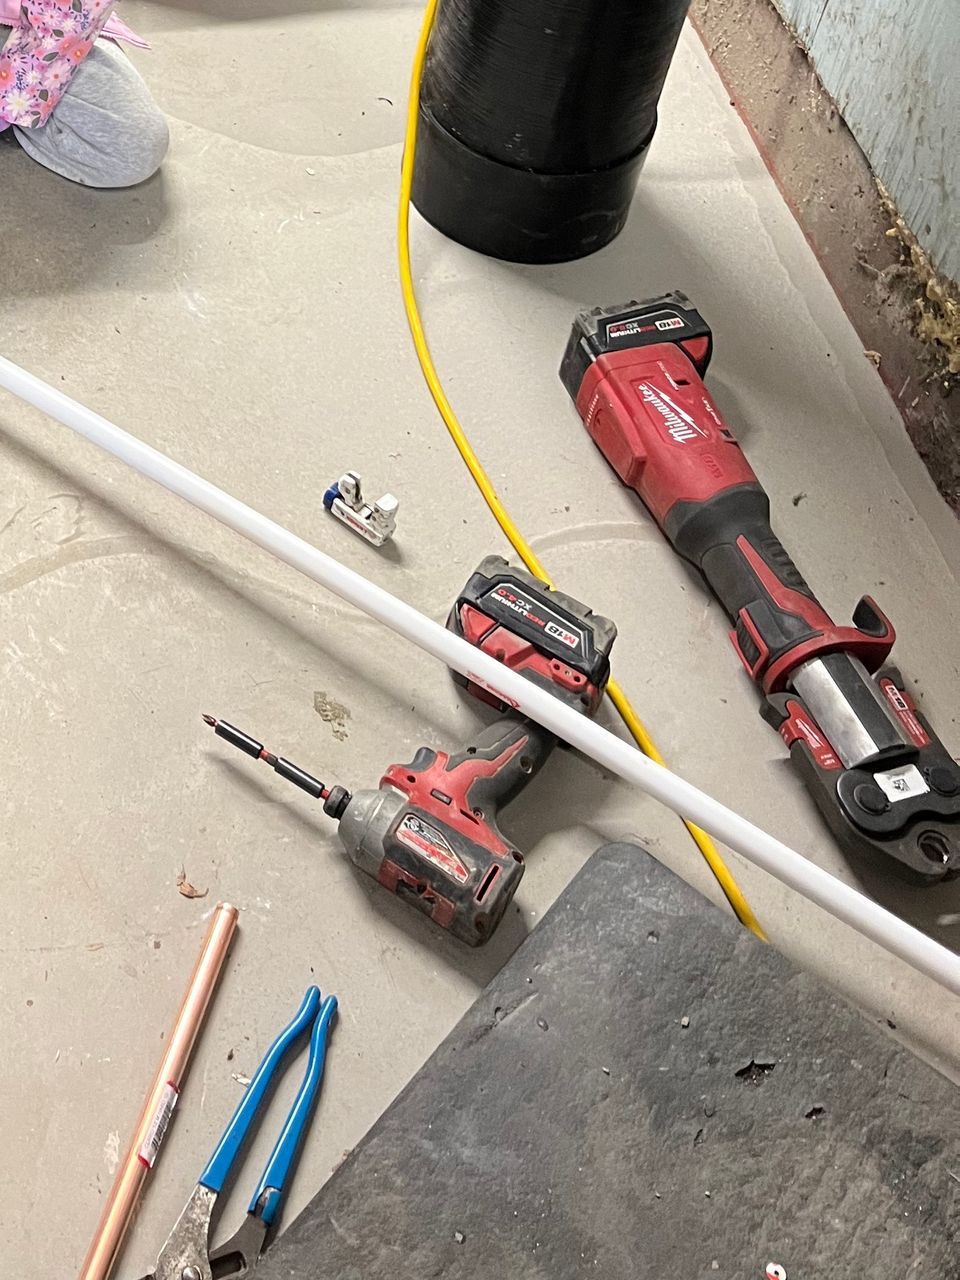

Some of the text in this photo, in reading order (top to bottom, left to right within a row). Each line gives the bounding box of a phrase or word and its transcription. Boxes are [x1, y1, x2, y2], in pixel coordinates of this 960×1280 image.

[658, 319, 683, 330] M18
[637, 382, 698, 444] Milwaukee
[546, 624, 579, 647] M18
